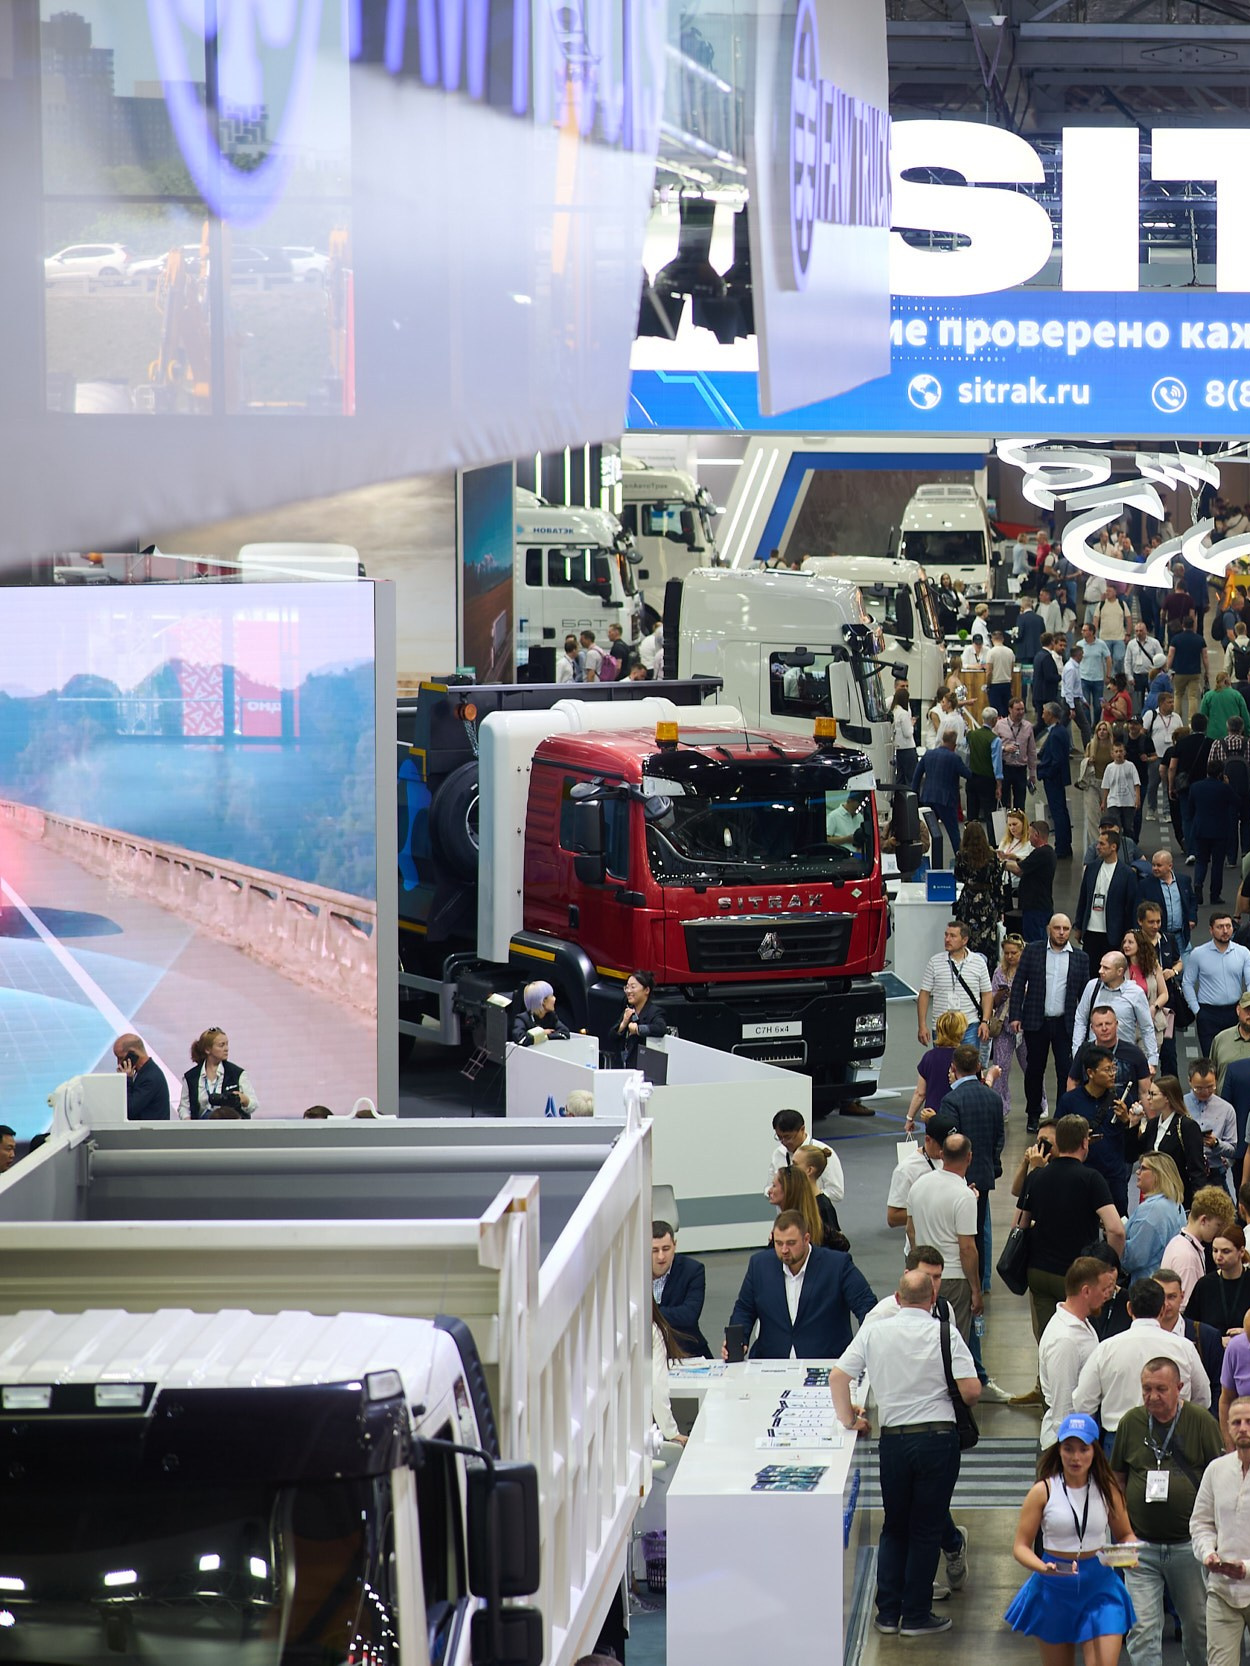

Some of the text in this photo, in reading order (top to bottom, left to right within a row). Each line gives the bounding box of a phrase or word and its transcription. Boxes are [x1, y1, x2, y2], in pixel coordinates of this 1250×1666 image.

[939, 320, 1170, 355] проверено
[958, 376, 1090, 405] sitrak.ru
[533, 527, 574, 535] НОВАТЭК
[562, 619, 608, 628] БАТ
[718, 893, 824, 910] SITRAK
[755, 1025, 773, 1035] C7H
